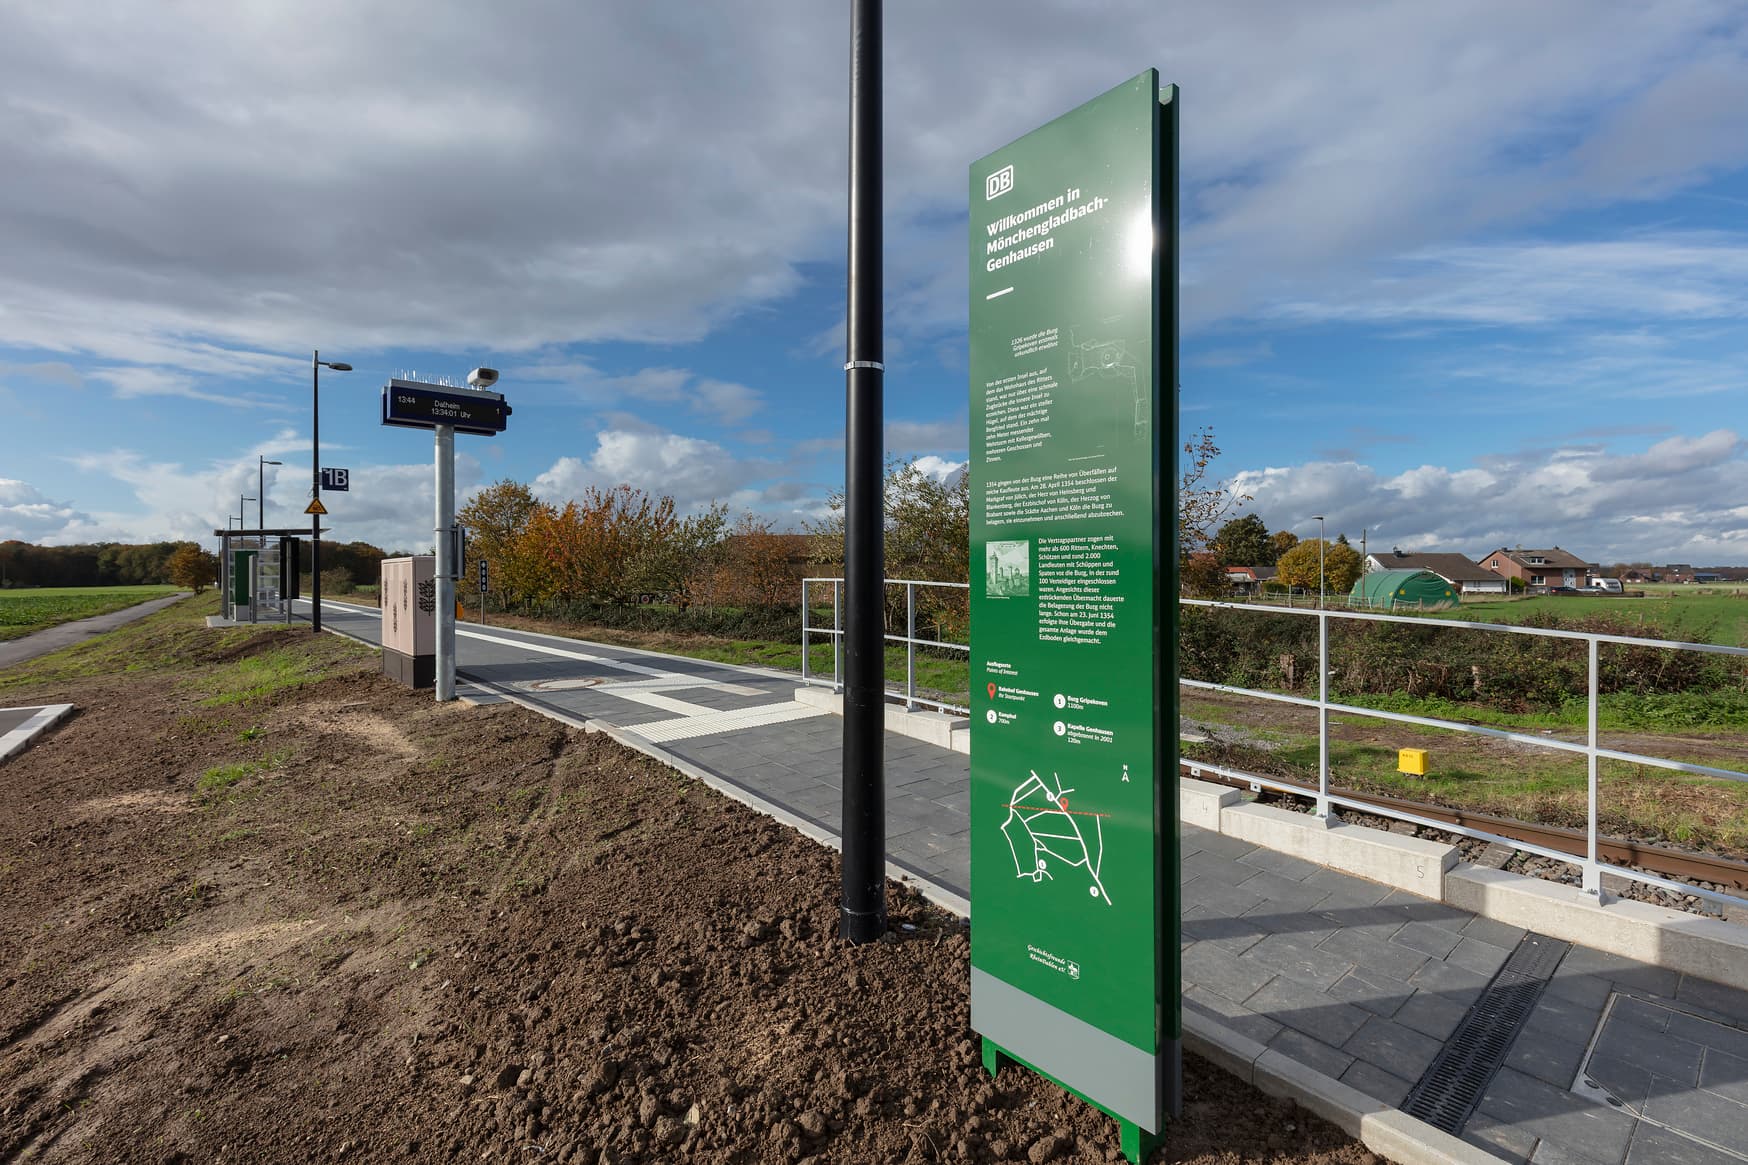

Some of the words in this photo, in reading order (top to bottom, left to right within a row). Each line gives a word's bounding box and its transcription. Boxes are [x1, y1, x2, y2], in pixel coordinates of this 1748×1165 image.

[990, 170, 1010, 195] DB
[987, 195, 1064, 236] Willkommen
[1067, 188, 1080, 202] in
[987, 196, 1109, 254] Mönchengladbach-
[987, 238, 1054, 272] Genhausen
[398, 396, 416, 404] 13:44
[434, 400, 460, 410] Dalheim
[432, 408, 456, 417] 13:34:01
[326, 469, 347, 486] 1B
